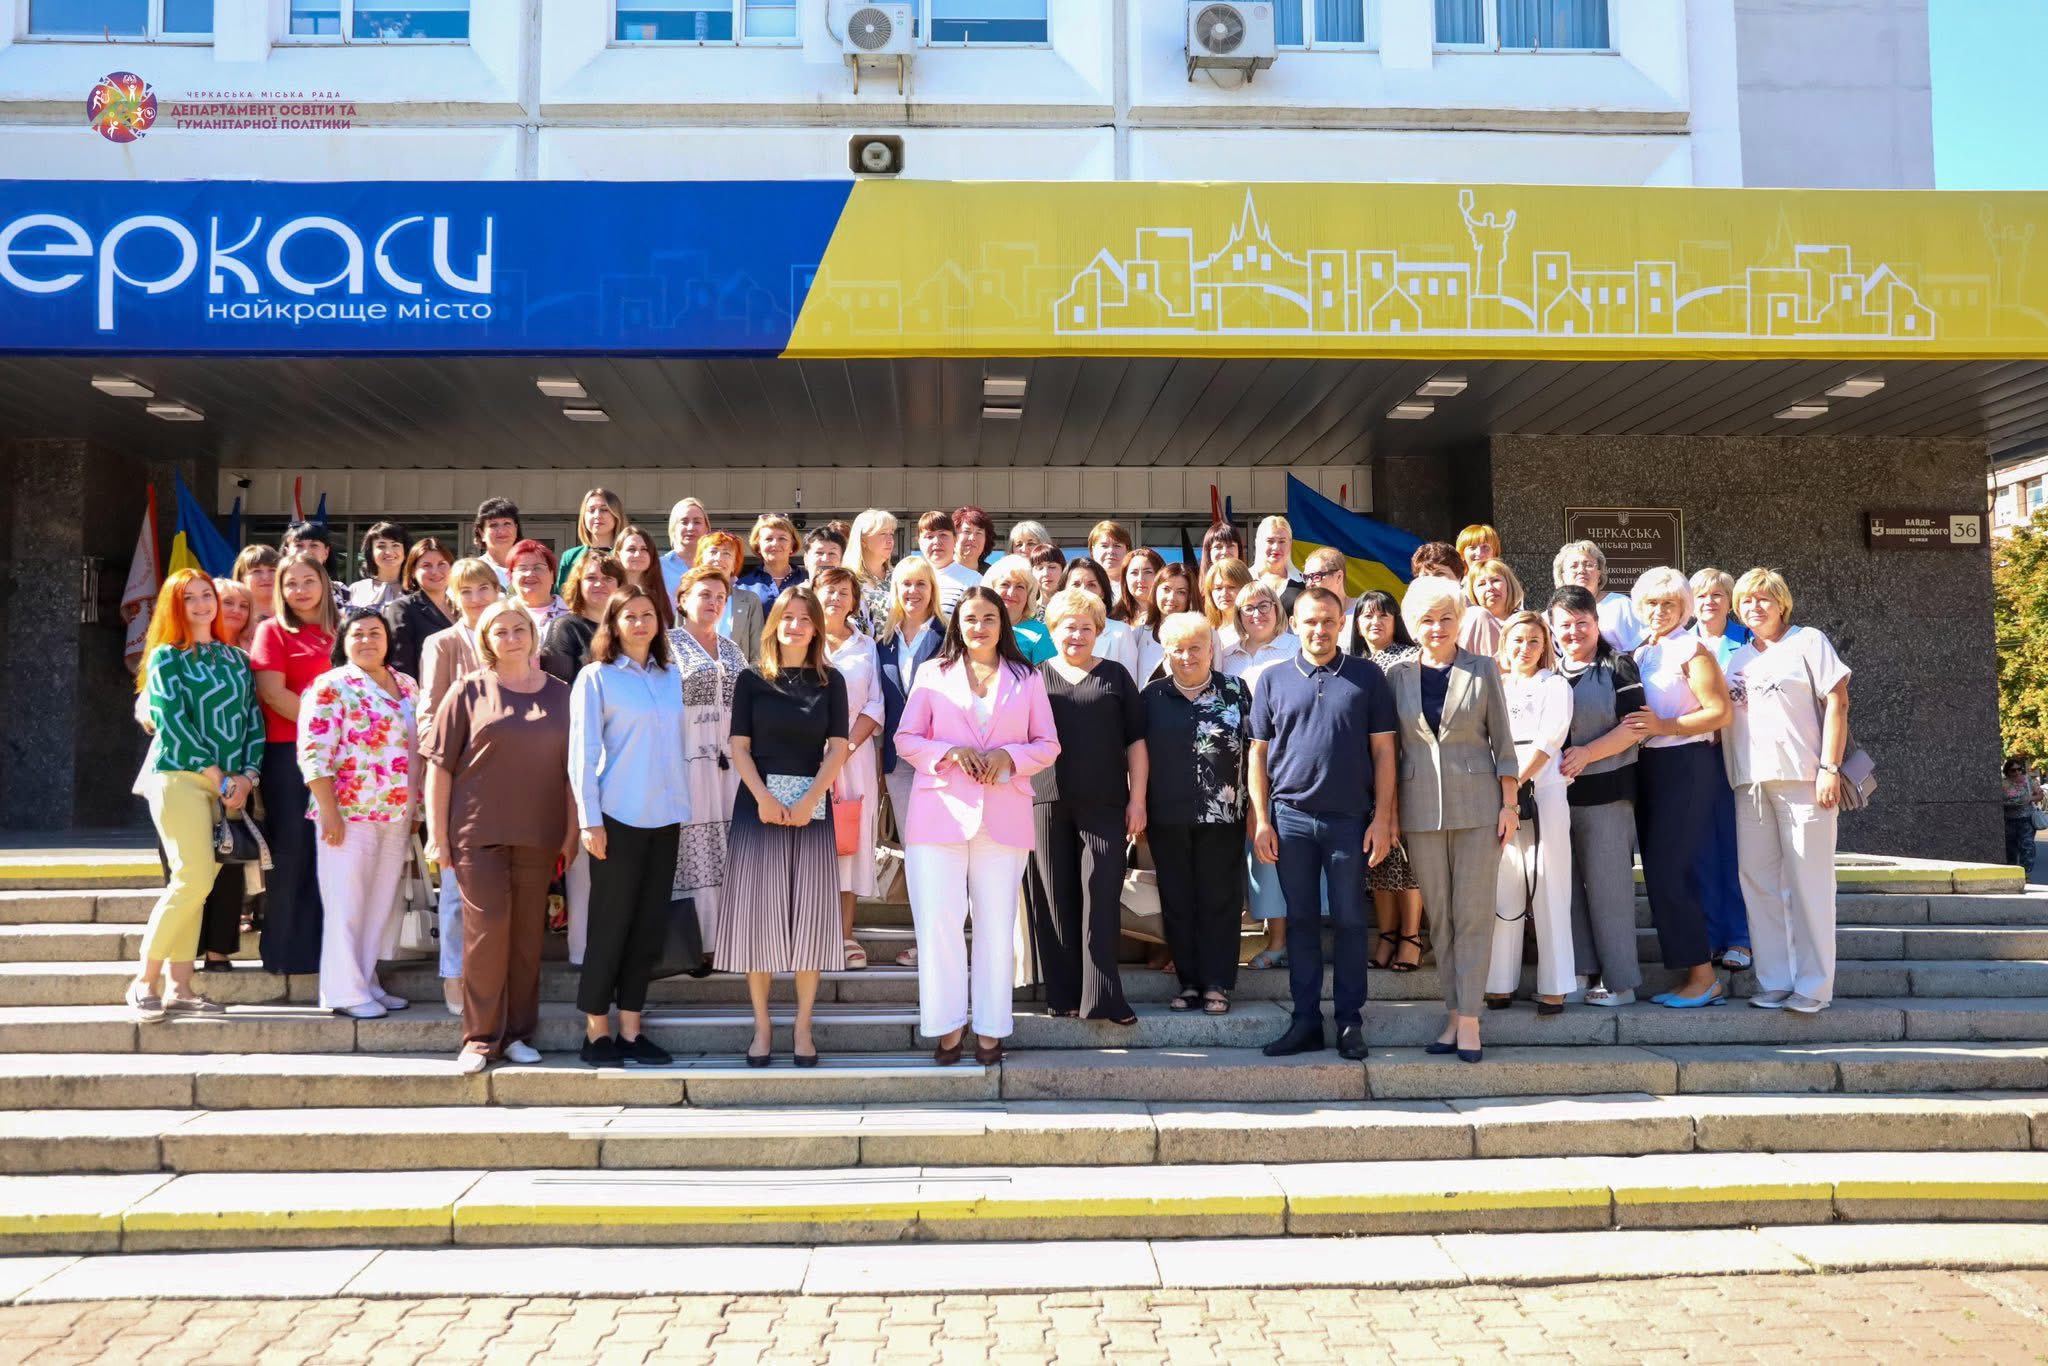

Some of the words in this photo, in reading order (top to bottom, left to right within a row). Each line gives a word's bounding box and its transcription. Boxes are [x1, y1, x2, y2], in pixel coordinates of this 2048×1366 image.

[209, 299, 388, 324] найкраще
[398, 299, 493, 320] місто
[1587, 528, 1661, 539] ЧЕРКАСЬКА
[1954, 523, 1977, 538] 36
[1597, 540, 1628, 549] міська
[1631, 542, 1652, 551] рада
